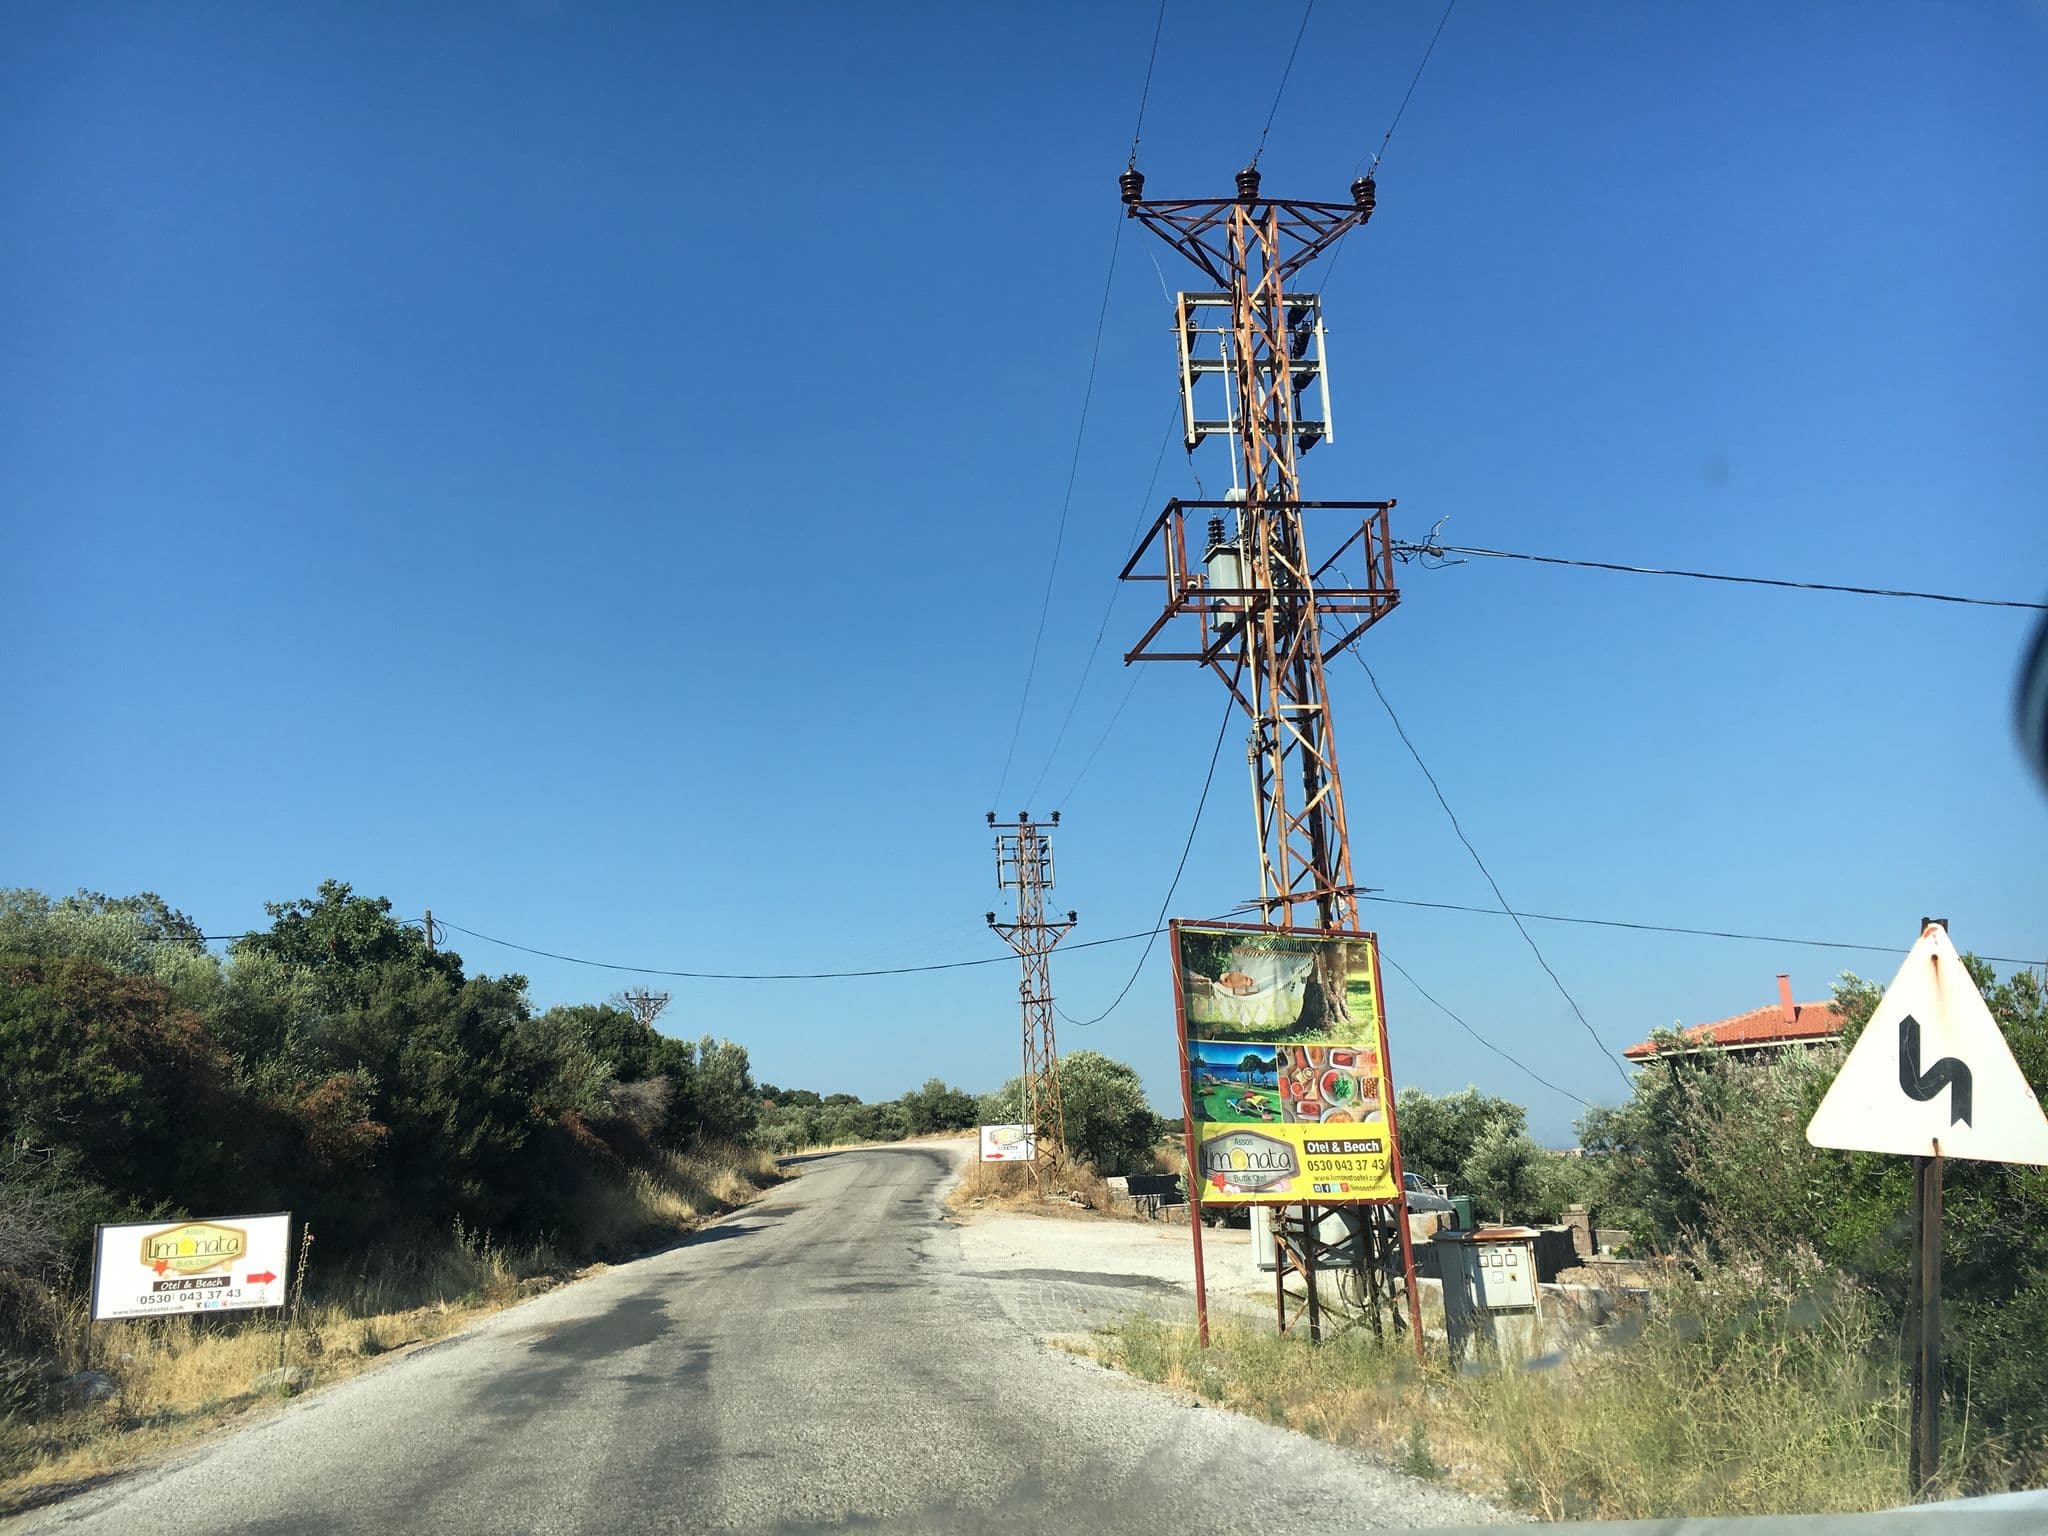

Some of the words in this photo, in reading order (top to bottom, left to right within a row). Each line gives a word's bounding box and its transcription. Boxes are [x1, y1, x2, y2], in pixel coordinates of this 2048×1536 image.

[1233, 1137, 1254, 1146] Assos
[1306, 1141, 1330, 1153] Otel
[1331, 1141, 1341, 1153] &
[1343, 1140, 1380, 1153] Beach
[1307, 1159, 1333, 1171] 0530
[1334, 1159, 1354, 1171] 043
[1355, 1159, 1368, 1171] 37
[1371, 1158, 1385, 1170] 43
[160, 1280, 180, 1291] Otel
[183, 1280, 193, 1289] &
[195, 1278, 223, 1288] Beach
[136, 1293, 175, 1305] (0530)
[179, 1291, 203, 1302] 043
[207, 1290, 222, 1300] 37
[226, 1288, 242, 1298] 43
